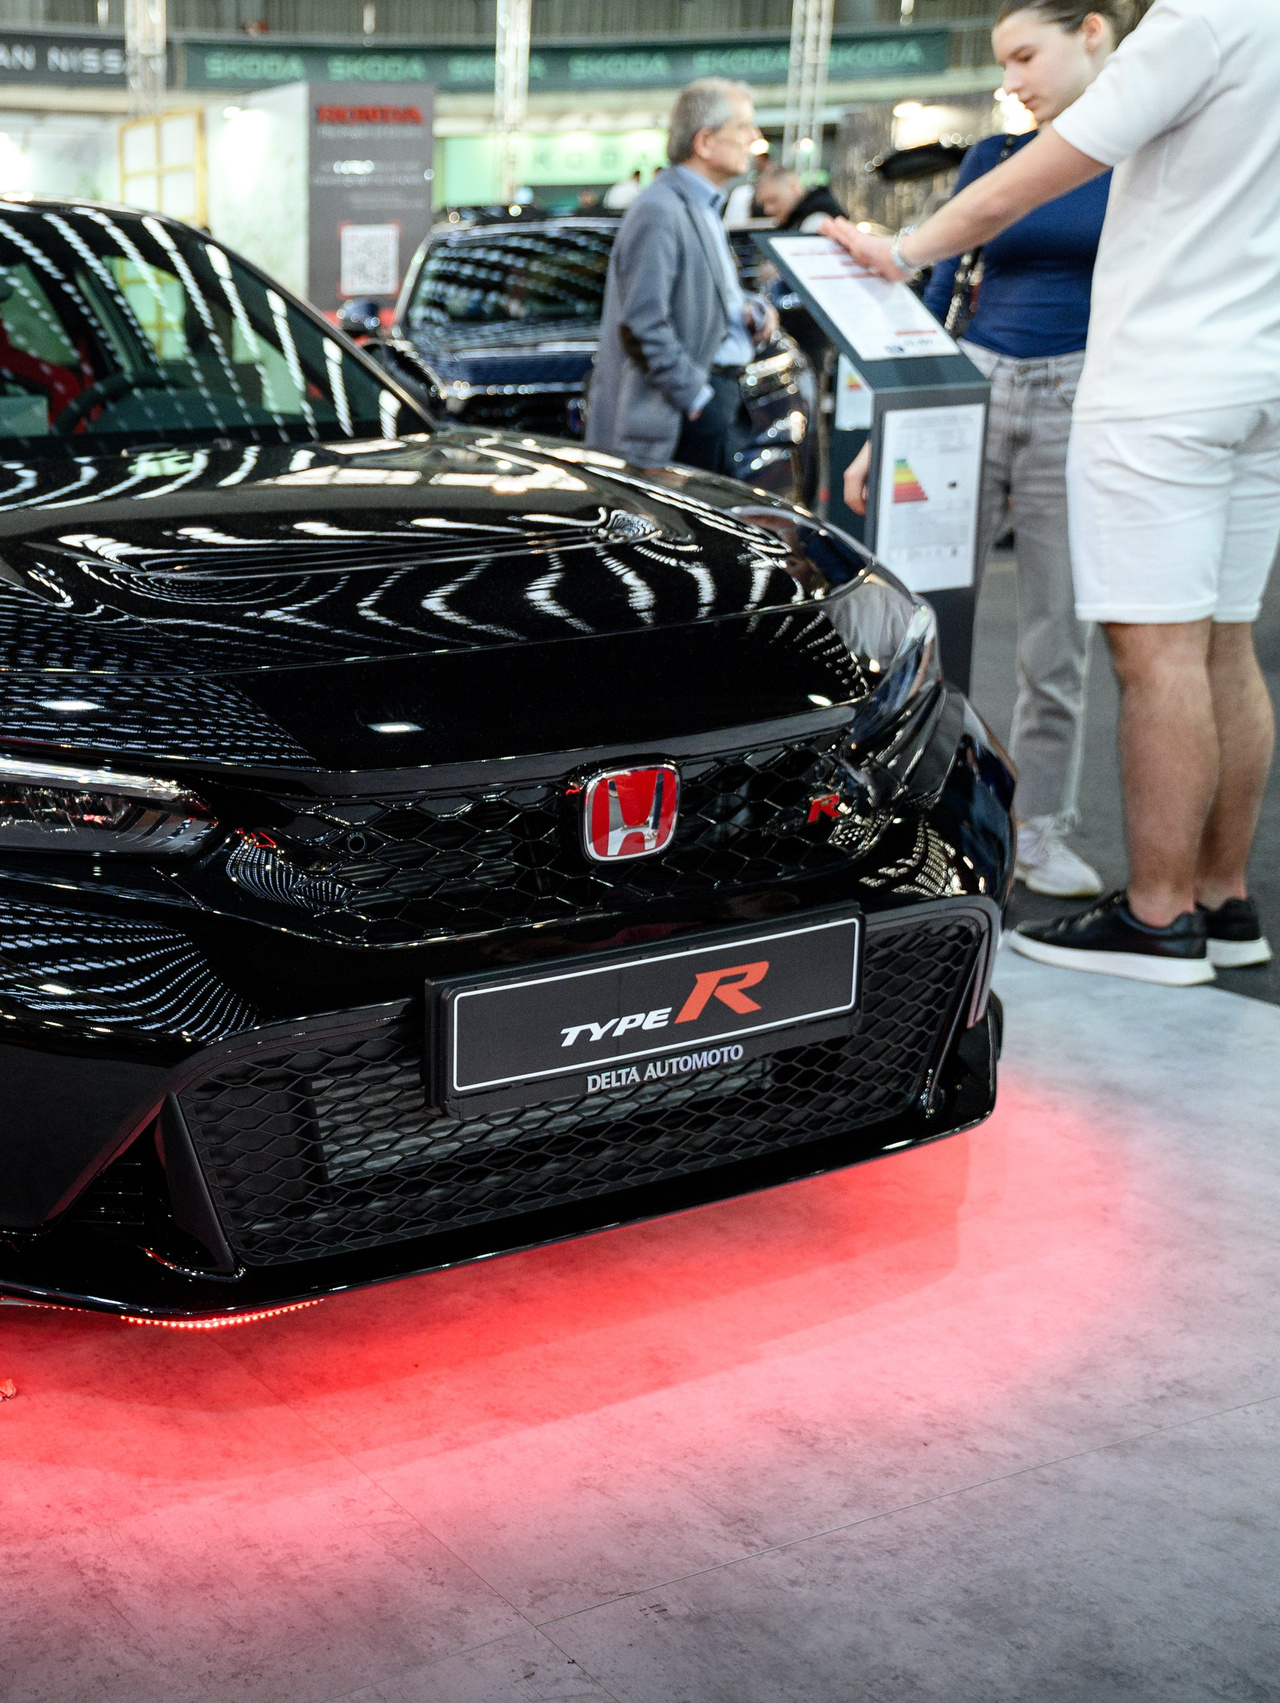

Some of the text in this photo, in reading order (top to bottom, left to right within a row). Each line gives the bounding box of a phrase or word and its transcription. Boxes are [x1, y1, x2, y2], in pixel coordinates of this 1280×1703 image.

[47, 45, 125, 75] NISS
[317, 104, 423, 125] HONDA
[807, 793, 841, 823] R
[560, 960, 770, 1047] TYPE R
[587, 1044, 744, 1093] DELTA AUTOMOTO
